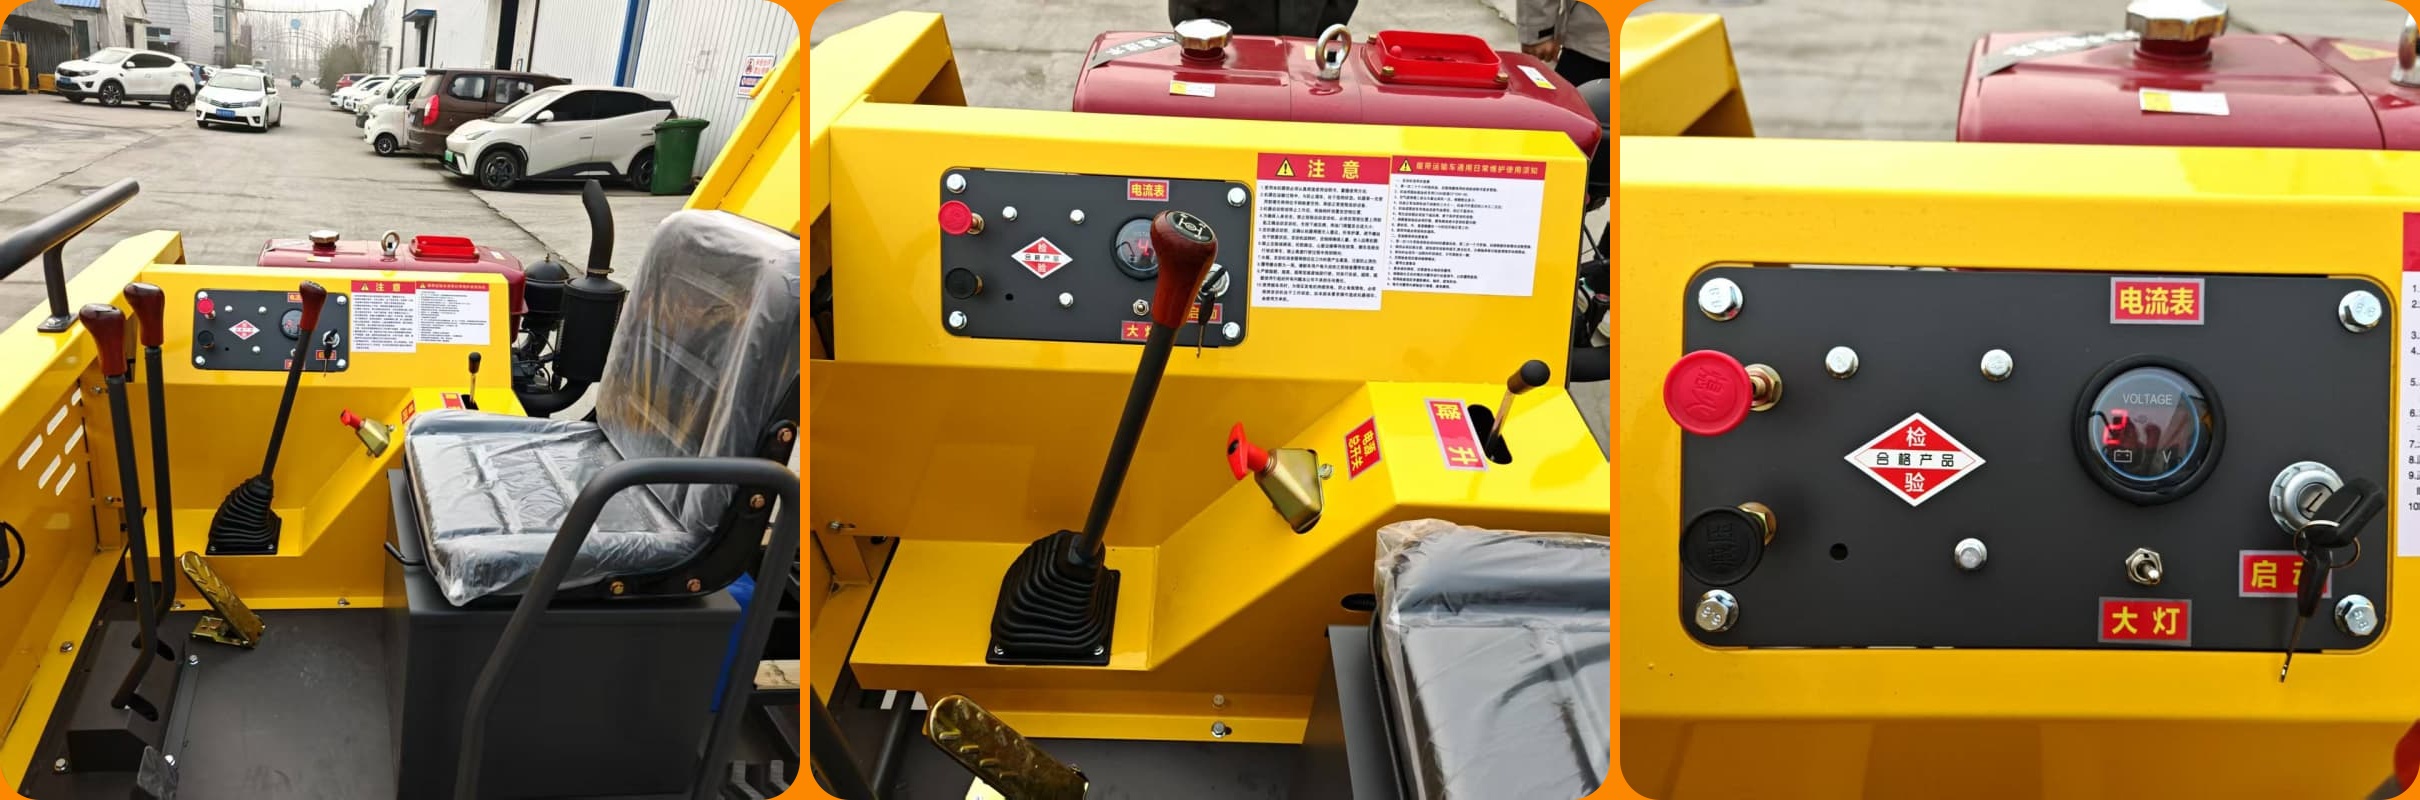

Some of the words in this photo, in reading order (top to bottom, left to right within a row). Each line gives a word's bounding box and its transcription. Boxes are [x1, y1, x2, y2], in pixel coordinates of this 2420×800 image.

[1307, 159, 1360, 180] 注意
[1131, 183, 1165, 197] 电流表
[2119, 286, 2195, 316] 电流表
[2122, 393, 2173, 406] VOLTAGE
[1906, 426, 1927, 447] 检
[2102, 408, 2129, 446] 2
[1348, 434, 1364, 471] 总开关
[1362, 430, 1377, 457] 电源
[1876, 451, 1954, 467] 合格产品
[2161, 450, 2172, 464] V
[1904, 472, 1925, 492] 验
[2111, 606, 2181, 636] 大灯
